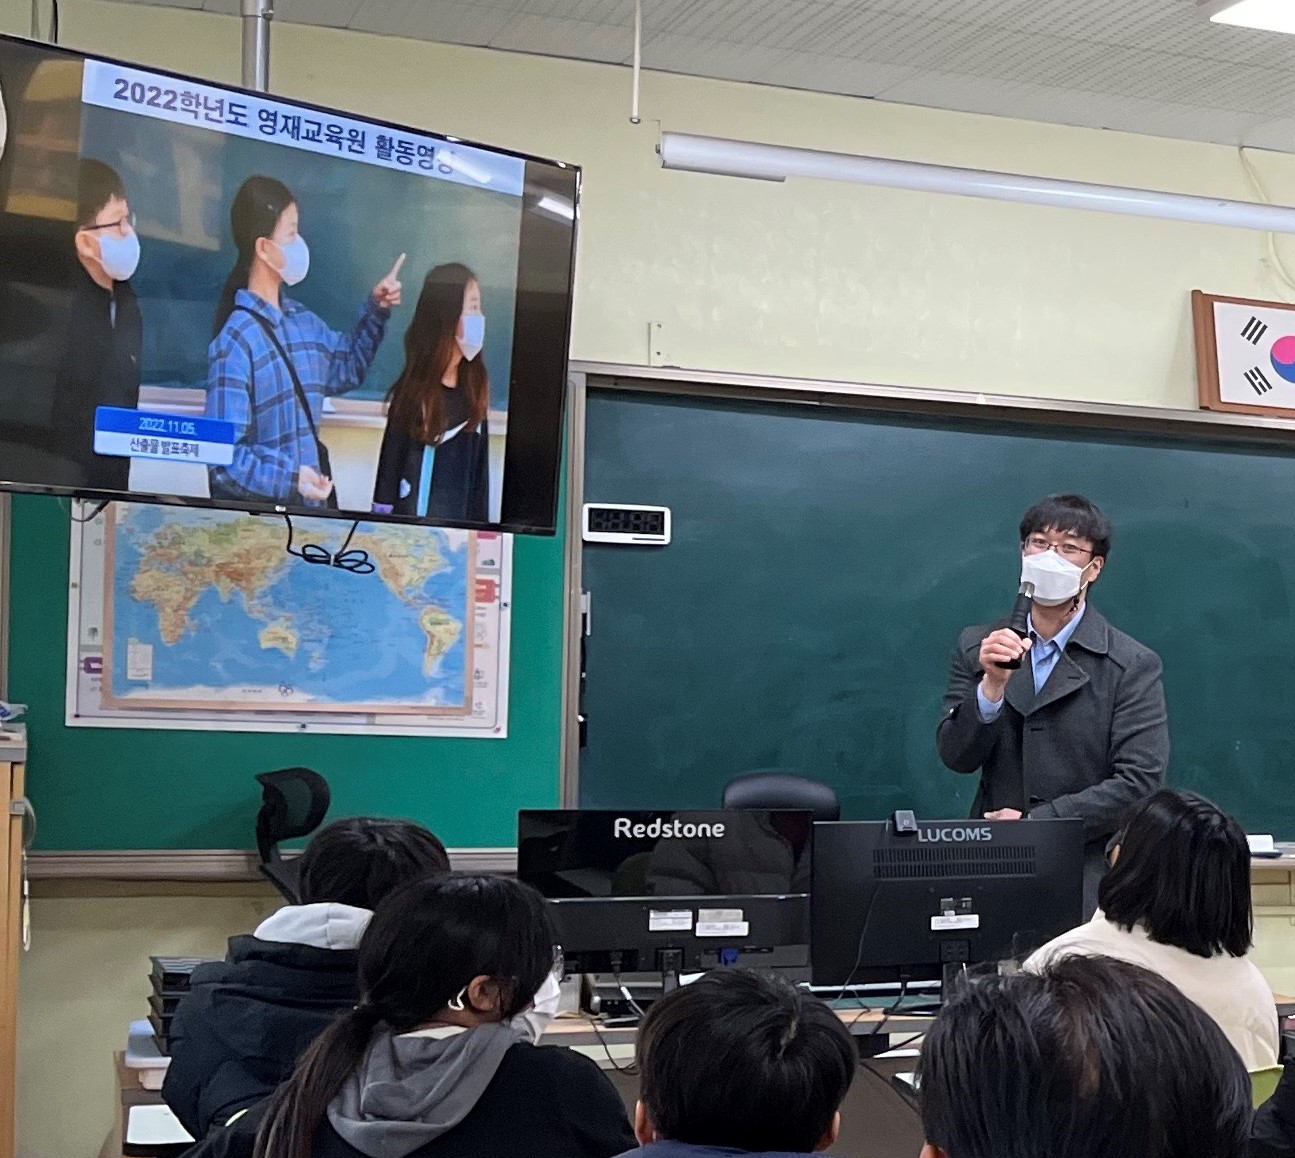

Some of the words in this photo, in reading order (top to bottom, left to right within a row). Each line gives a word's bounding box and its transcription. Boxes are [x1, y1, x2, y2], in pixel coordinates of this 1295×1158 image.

[113, 77, 249, 128] 2022학년도
[257, 107, 366, 156] 영재교육원
[613, 818, 725, 840] Redstone
[917, 827, 992, 843] LUCOMS
